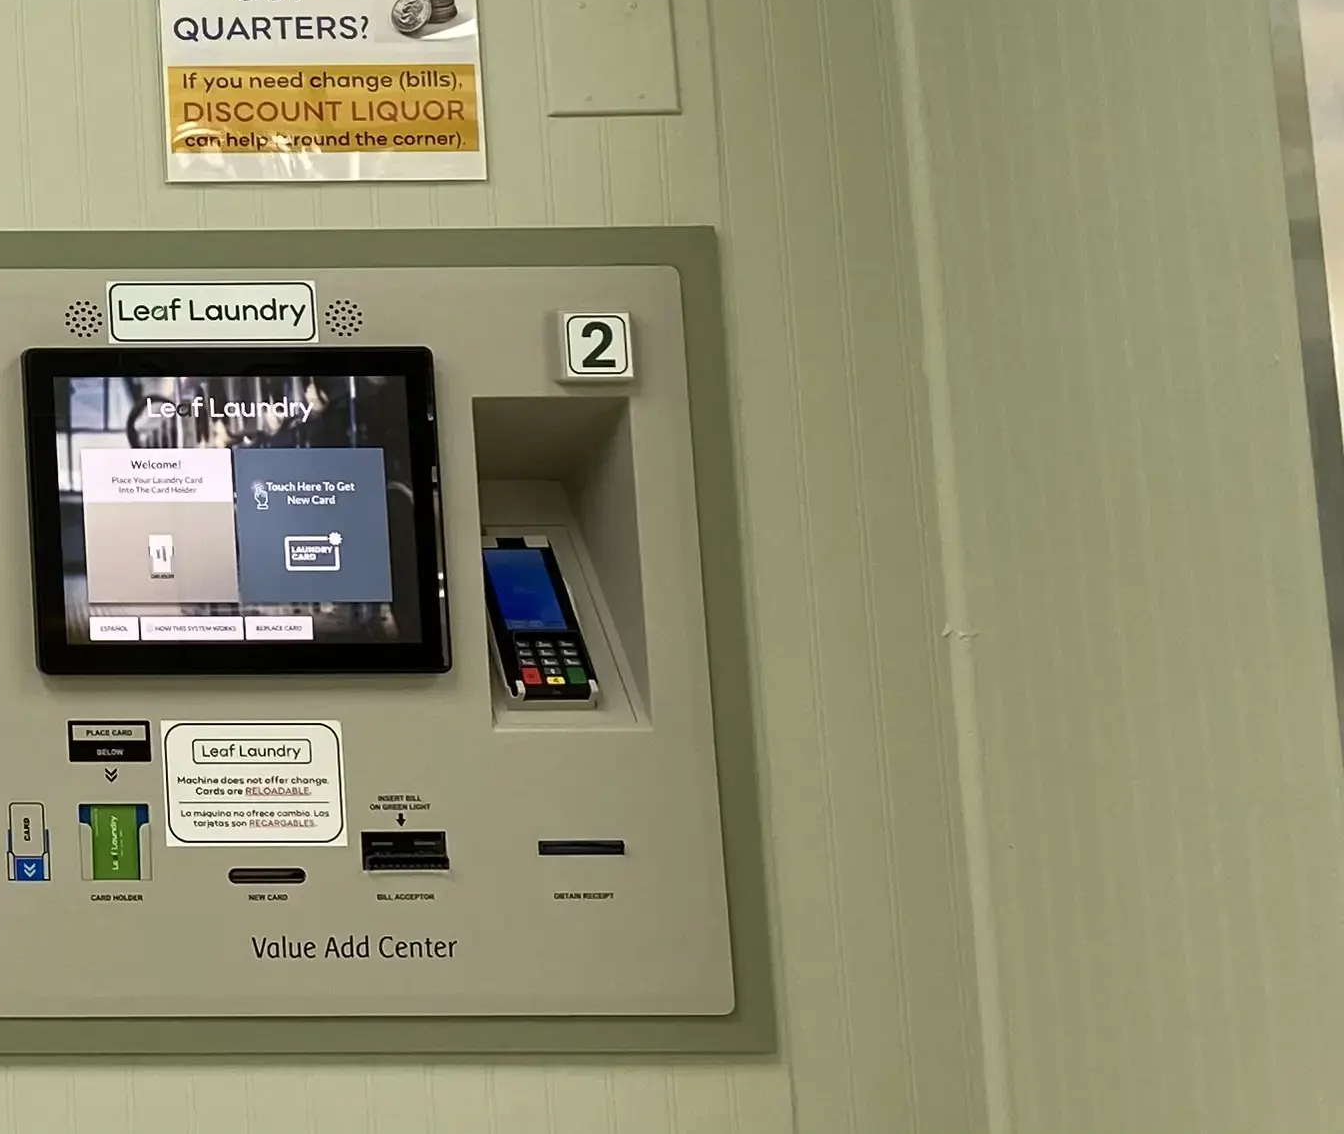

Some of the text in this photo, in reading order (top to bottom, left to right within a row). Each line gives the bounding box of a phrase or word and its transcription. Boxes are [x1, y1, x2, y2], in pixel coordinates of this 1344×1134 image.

[173, 15, 369, 42] QUARTERS?
[182, 70, 463, 93] If you need change (bills),
[183, 100, 464, 123] DISCOUNT LIQUOR
[185, 135, 221, 147] can
[226, 132, 268, 151] help
[275, 131, 350, 149] round
[355, 131, 388, 147] the
[117, 297, 307, 327] Leaf Laundry
[581, 320, 617, 369] 2
[209, 396, 314, 423] Laundry
[130, 460, 181, 470] Welcome!
[265, 481, 355, 492] Touch Here To Get
[287, 495, 336, 505] New Card
[291, 553, 317, 561] CARD
[201, 744, 301, 760] Leaf Laundry
[177, 776, 329, 786] Machine does not offer change.
[195, 787, 225, 795] Cards
[245, 787, 312, 796] RELOADABLE.
[23, 817, 31, 842] CARD
[251, 935, 458, 959] Value Add Center
